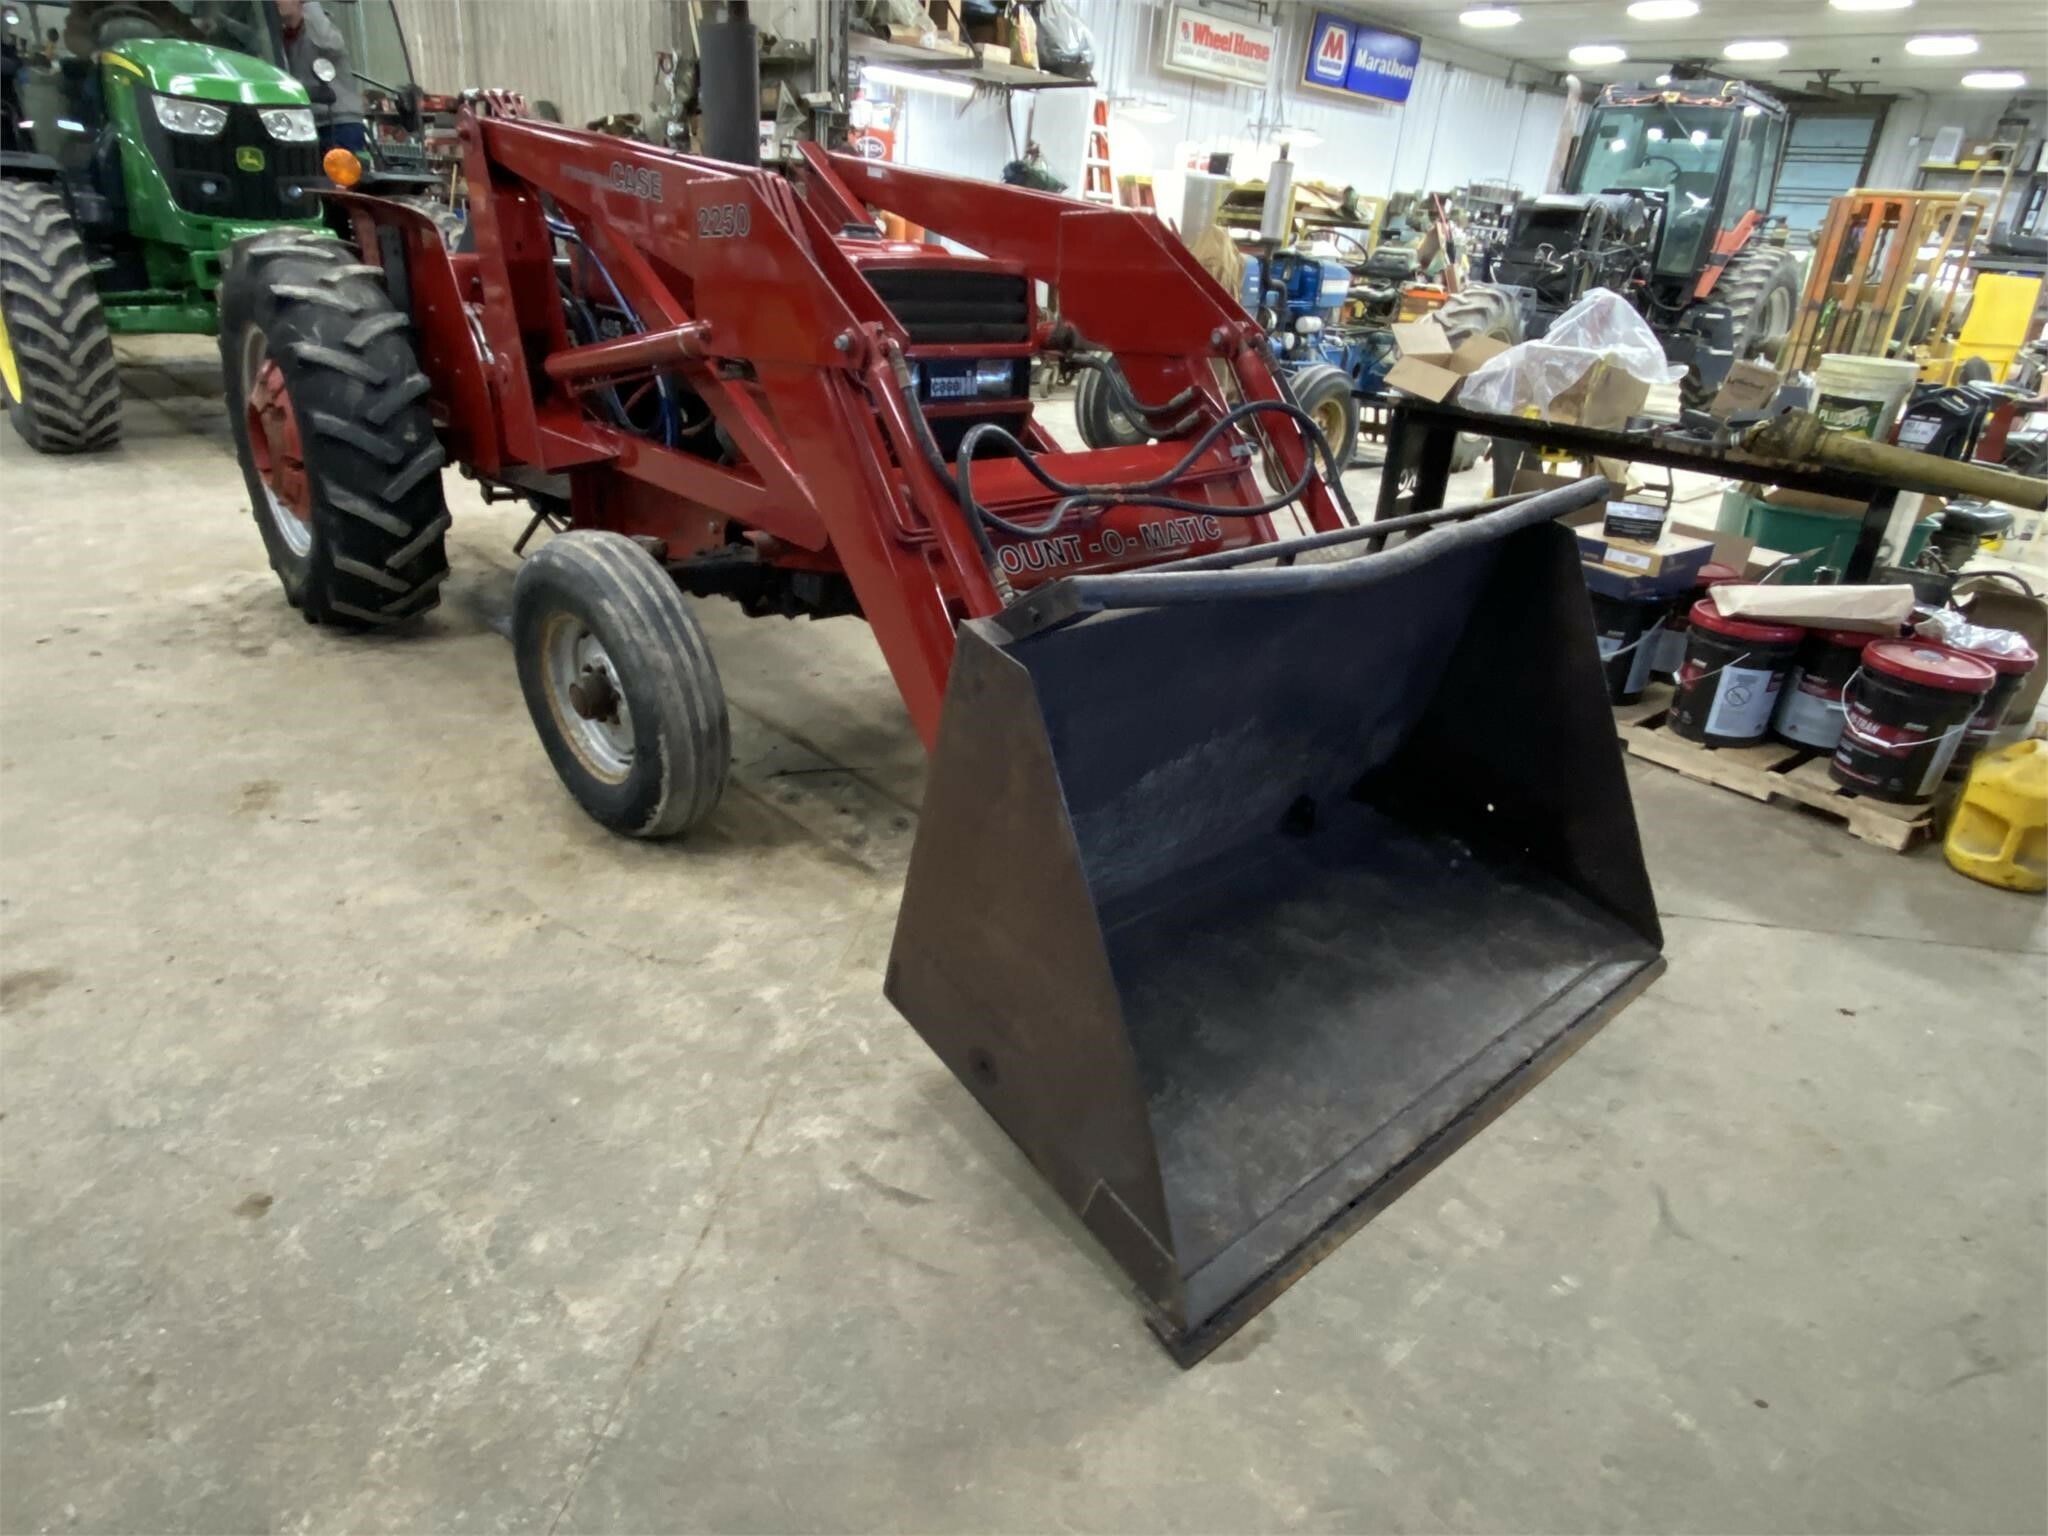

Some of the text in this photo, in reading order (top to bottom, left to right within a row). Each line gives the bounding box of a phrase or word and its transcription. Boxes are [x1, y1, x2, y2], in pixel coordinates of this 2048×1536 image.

[1192, 22, 1270, 62] Wheel Horse
[1321, 30, 1345, 60] M
[1354, 47, 1415, 81] Marathon
[609, 160, 663, 203] CASE
[698, 203, 751, 239] 2250
[997, 535, 1082, 574] OUNT
[1139, 514, 1222, 549] MATIC
